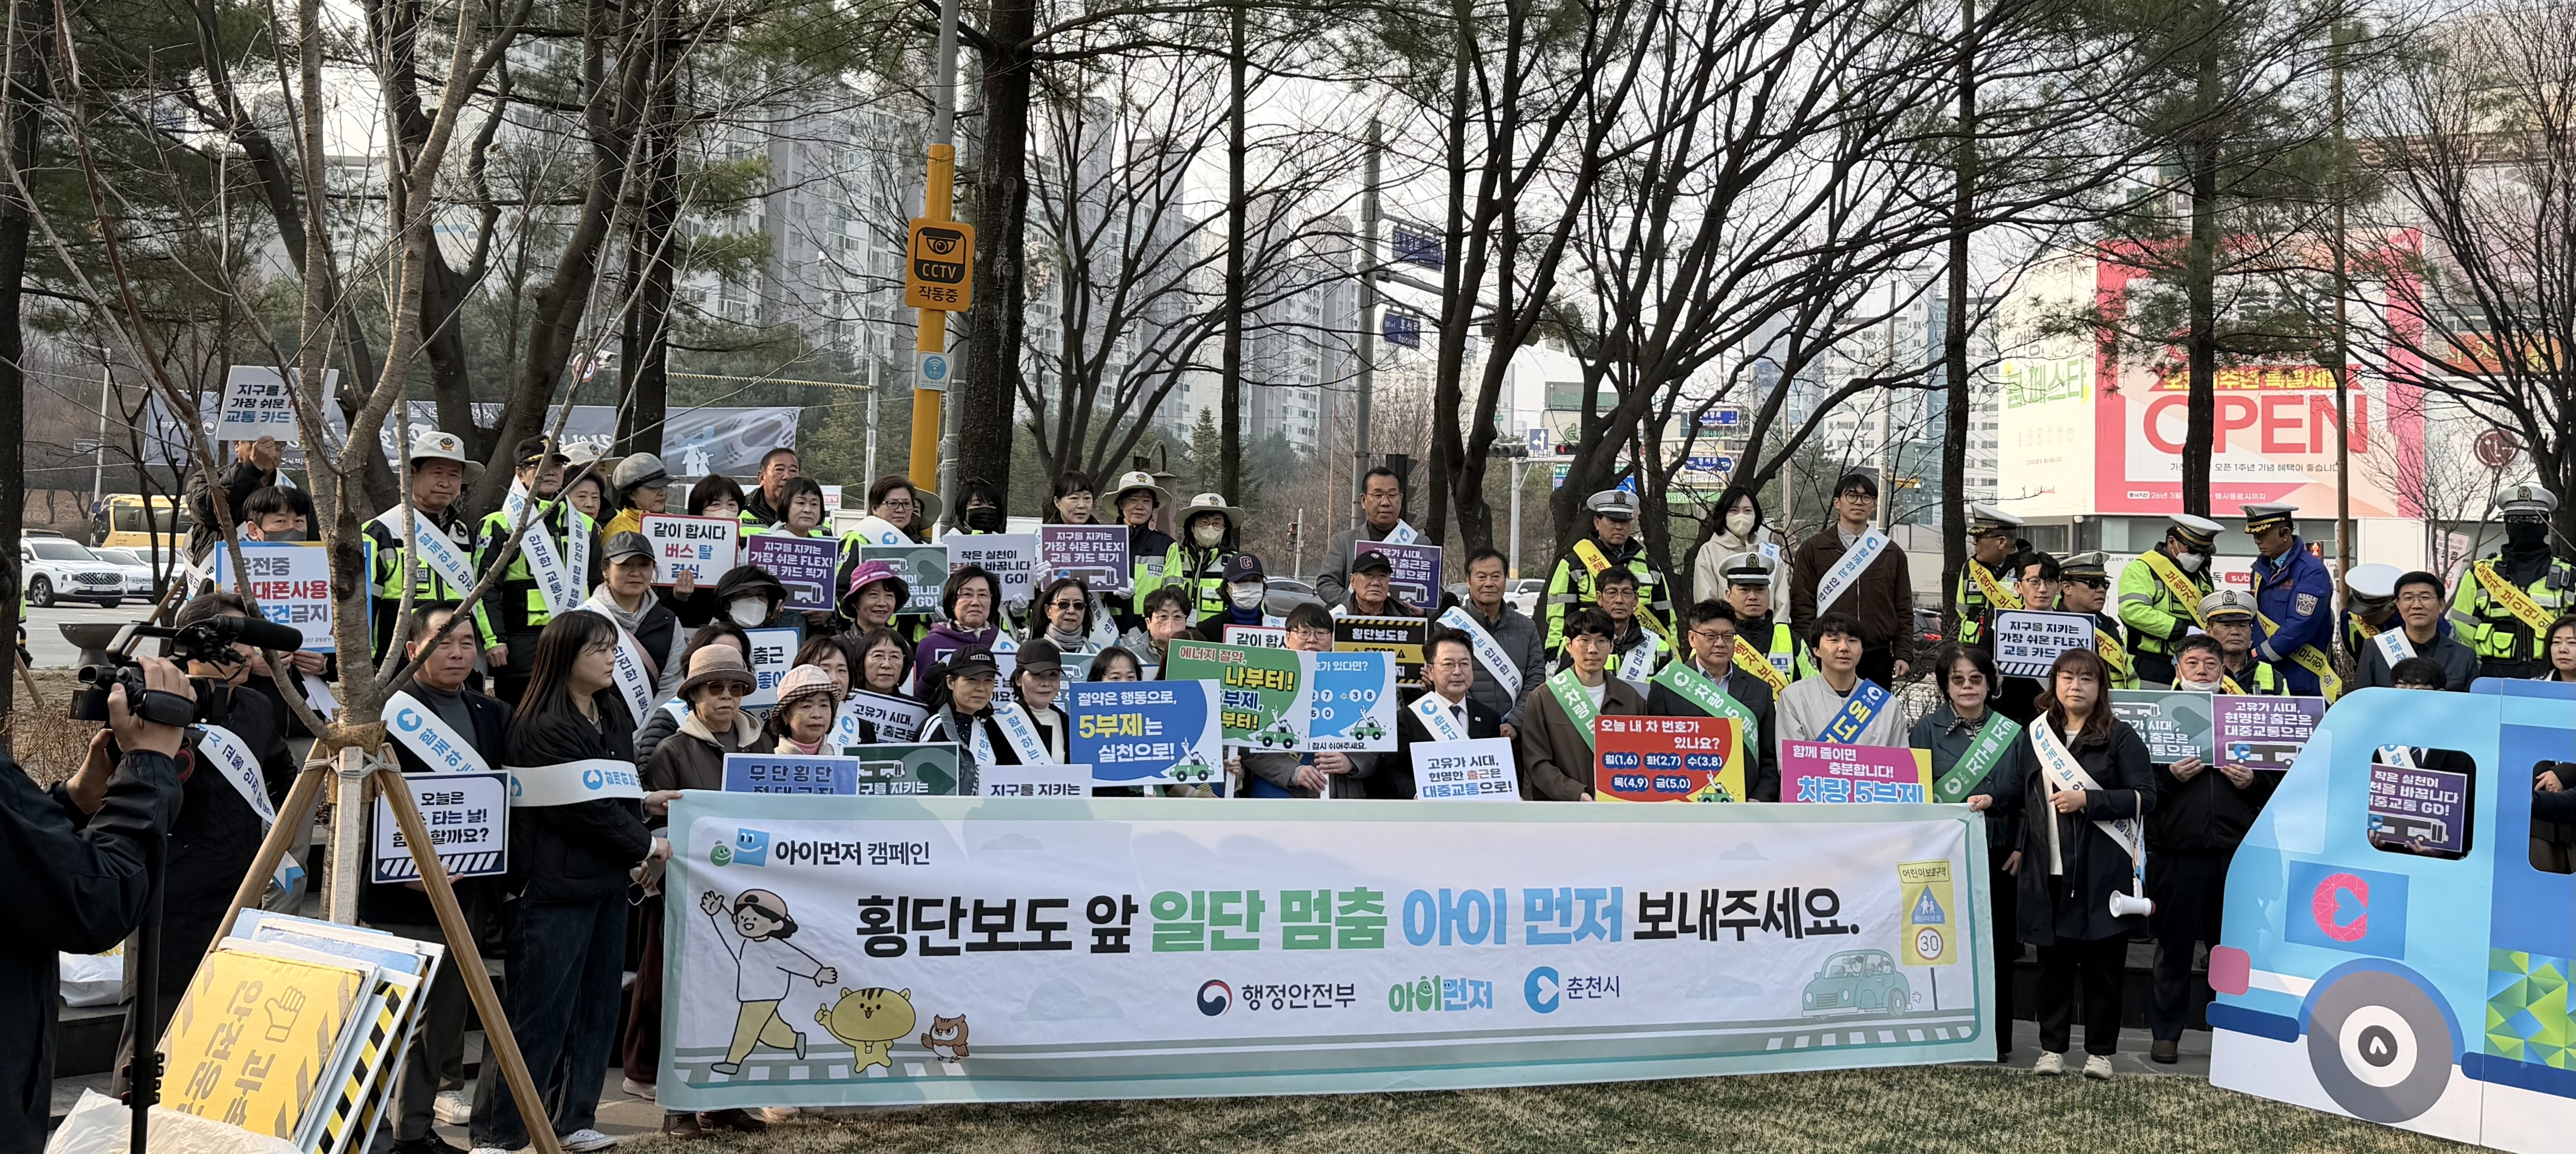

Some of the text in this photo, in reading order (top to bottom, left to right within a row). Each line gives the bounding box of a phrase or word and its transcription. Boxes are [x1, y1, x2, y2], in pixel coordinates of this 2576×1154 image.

[922, 263, 956, 280] CCTV
[918, 285, 958, 303] 작동중
[237, 384, 279, 395] 지구를
[231, 398, 284, 408] 가장 쉬운
[224, 411, 291, 423] 교통 카드
[2143, 394, 2369, 454] OPEN
[2278, 463, 2303, 472] 혜택이
[654, 522, 726, 540] 같이 합시다
[1056, 532, 1113, 541] 지구를 지키는
[417, 533, 460, 573] 함께하는
[528, 535, 552, 569] 안전한
[665, 544, 713, 560] 버스 탈
[764, 542, 821, 555] 지구를 지키는
[1044, 541, 1124, 552] 가장 쉬운 FLEX!
[750, 551, 833, 568] 가장 쉬운 FLEX!
[961, 550, 1017, 560] 작은 실천이
[1050, 553, 1119, 563] 교통 카드 찍기
[1403, 550, 1422, 559] 시대,
[985, 562, 1031, 573] 바꿉니다
[1240, 556, 1253, 570] G
[1400, 559, 1430, 570] 출근은
[1838, 547, 1870, 579] 함께하는
[781, 565, 827, 579] 카드 찍기
[1005, 573, 1028, 584] GO!
[2165, 570, 2197, 603] 보행자
[2477, 563, 2540, 624] 보행자 보이면
[915, 597, 938, 608] GO!
[1352, 629, 1408, 641] 횡단보도앞
[2010, 621, 2079, 634] 지구를 지키는
[1999, 633, 2089, 648] 가장 쉬운 FLEX!
[753, 647, 784, 665] 출근
[1179, 646, 1247, 665] 에너지 절약,
[2004, 645, 2056, 658] 교통 카드
[1333, 660, 1368, 672] 있다면?
[1225, 666, 1294, 691] 나부터!
[1077, 691, 1177, 706] 절약은 행동으로,
[1324, 692, 1373, 700] 7 3 8
[1564, 688, 1590, 719] 차량
[1694, 683, 1724, 709] 차량
[2235, 702, 2301, 713] 고유가 시대,
[853, 704, 913, 727] 고유가 시대,
[1221, 711, 1260, 729] 부터!
[2225, 713, 2312, 725] 현명한 출근은
[1079, 713, 1164, 738] 5부제는
[1601, 719, 1699, 734] 오늘 내 차 번호가
[2148, 720, 2180, 731] 시대,
[2225, 725, 2312, 737] 대중교통으로!
[1007, 715, 1040, 760] 함께하는
[1674, 737, 1720, 750] 있나요?
[2150, 733, 2188, 744] 출근은
[1098, 742, 1175, 763] 실천으로!
[1328, 741, 1367, 750] 쉬어주세요.
[1604, 754, 1722, 767] 월(1,6) 화(2,7) 수(3,8)
[1792, 746, 1856, 762] 함께 줄이면
[2041, 739, 2075, 782] 함께하는
[1428, 755, 1500, 770] 고유가 시대,
[749, 764, 832, 784] 무단횡단
[1429, 769, 1502, 783] 현명한 출근은
[1829, 763, 1894, 778] 충분합니다!
[1614, 777, 1691, 789] 목(4,9) 금(5,0)
[2375, 771, 2439, 788] 작은 실천이
[861, 782, 929, 795] 구를 지키는
[991, 783, 1081, 796] 지구를 지키는
[1422, 781, 1513, 798] 대중교통으로!
[1798, 776, 1925, 803] 차량 5부제
[2400, 786, 2459, 804] 바꿉니다
[421, 791, 464, 806] 오늘은
[2422, 802, 2450, 816] GO!
[432, 809, 487, 825] 타는 날!
[430, 827, 489, 846] 할까요?
[775, 840, 930, 866] 아이먼저 캠페인
[1902, 867, 1947, 879] 어린이보호구역
[856, 886, 1860, 957] 횡단보도 앞 일단 멈춤 아이 먼저 보내주세요.
[1920, 935, 1939, 952] 30
[1388, 975, 1493, 1012] 아이먼저
[1566, 976, 1620, 1000] 춘천시
[1242, 983, 1356, 1011] 행정안전부
